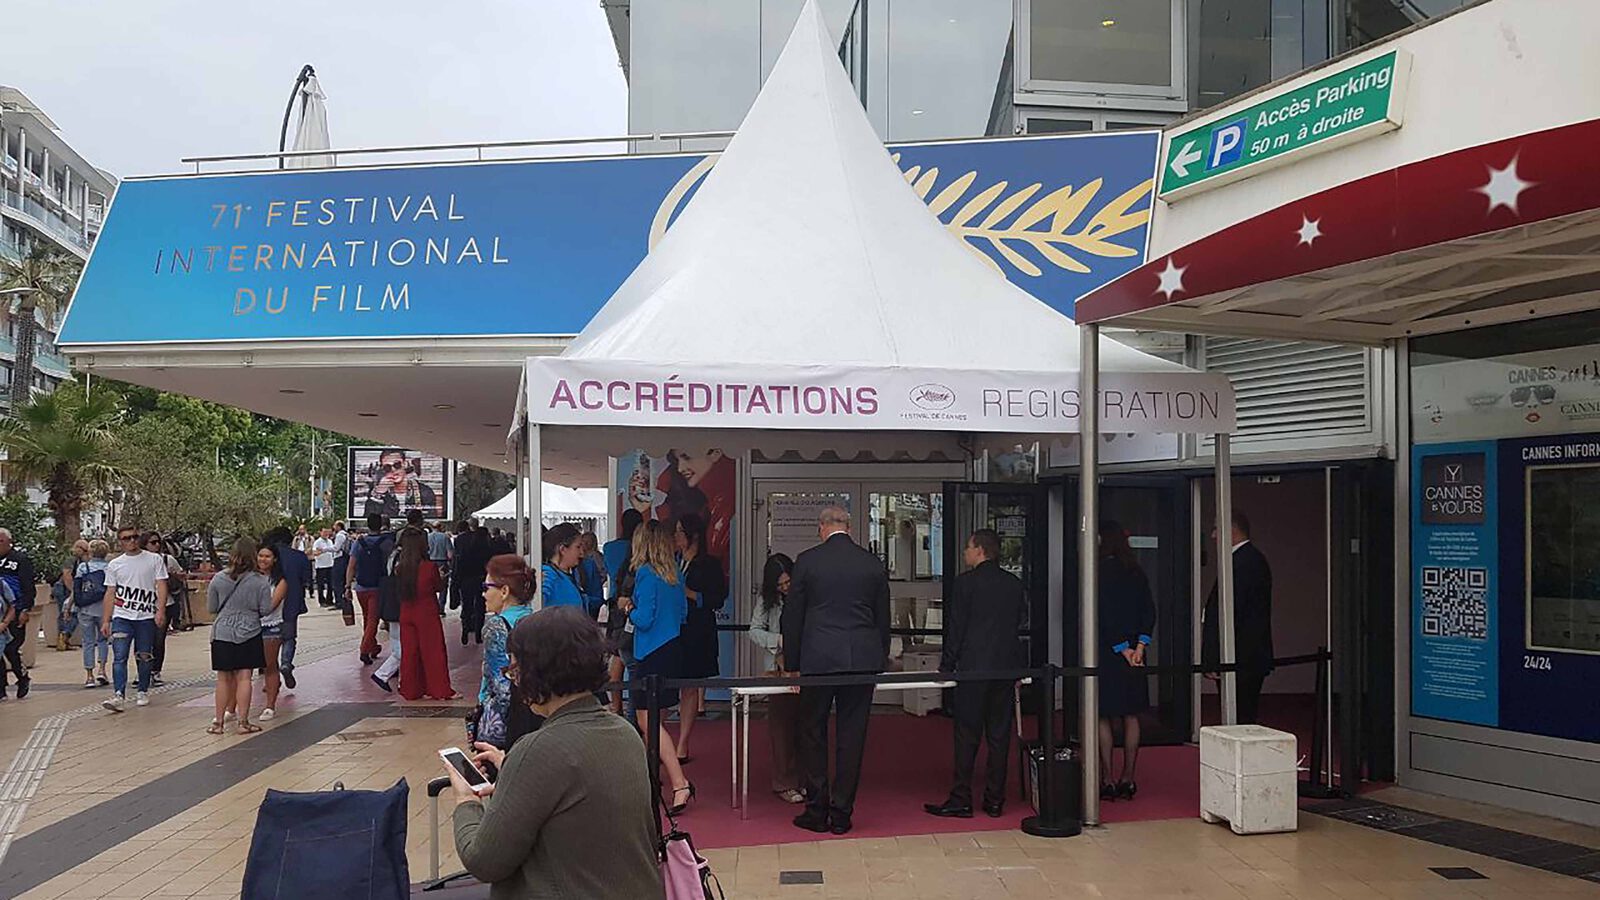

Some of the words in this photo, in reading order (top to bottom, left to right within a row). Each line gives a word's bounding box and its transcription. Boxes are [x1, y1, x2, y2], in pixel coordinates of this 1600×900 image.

[1254, 97, 1310, 131] Accès
[1315, 65, 1391, 109] Parking
[1211, 126, 1241, 168] P
[1250, 139, 1270, 157] 50
[1272, 134, 1289, 149] m
[1296, 125, 1308, 141] à
[1311, 105, 1365, 136] droite
[265, 193, 465, 228] FESTIVAL
[154, 236, 509, 275] INTERNATIONAL
[233, 286, 288, 316] DU
[311, 283, 410, 313] FILM
[1508, 366, 1556, 384] CANNES
[549, 373, 878, 416] ACCRÉDITATIONS
[982, 388, 1219, 420] REGISRATION
[1522, 445, 1562, 460] CANNES
[1425, 485, 1482, 501] CANNES
[1438, 500, 1482, 514] YOURS
[1523, 655, 1552, 671] 24/24
